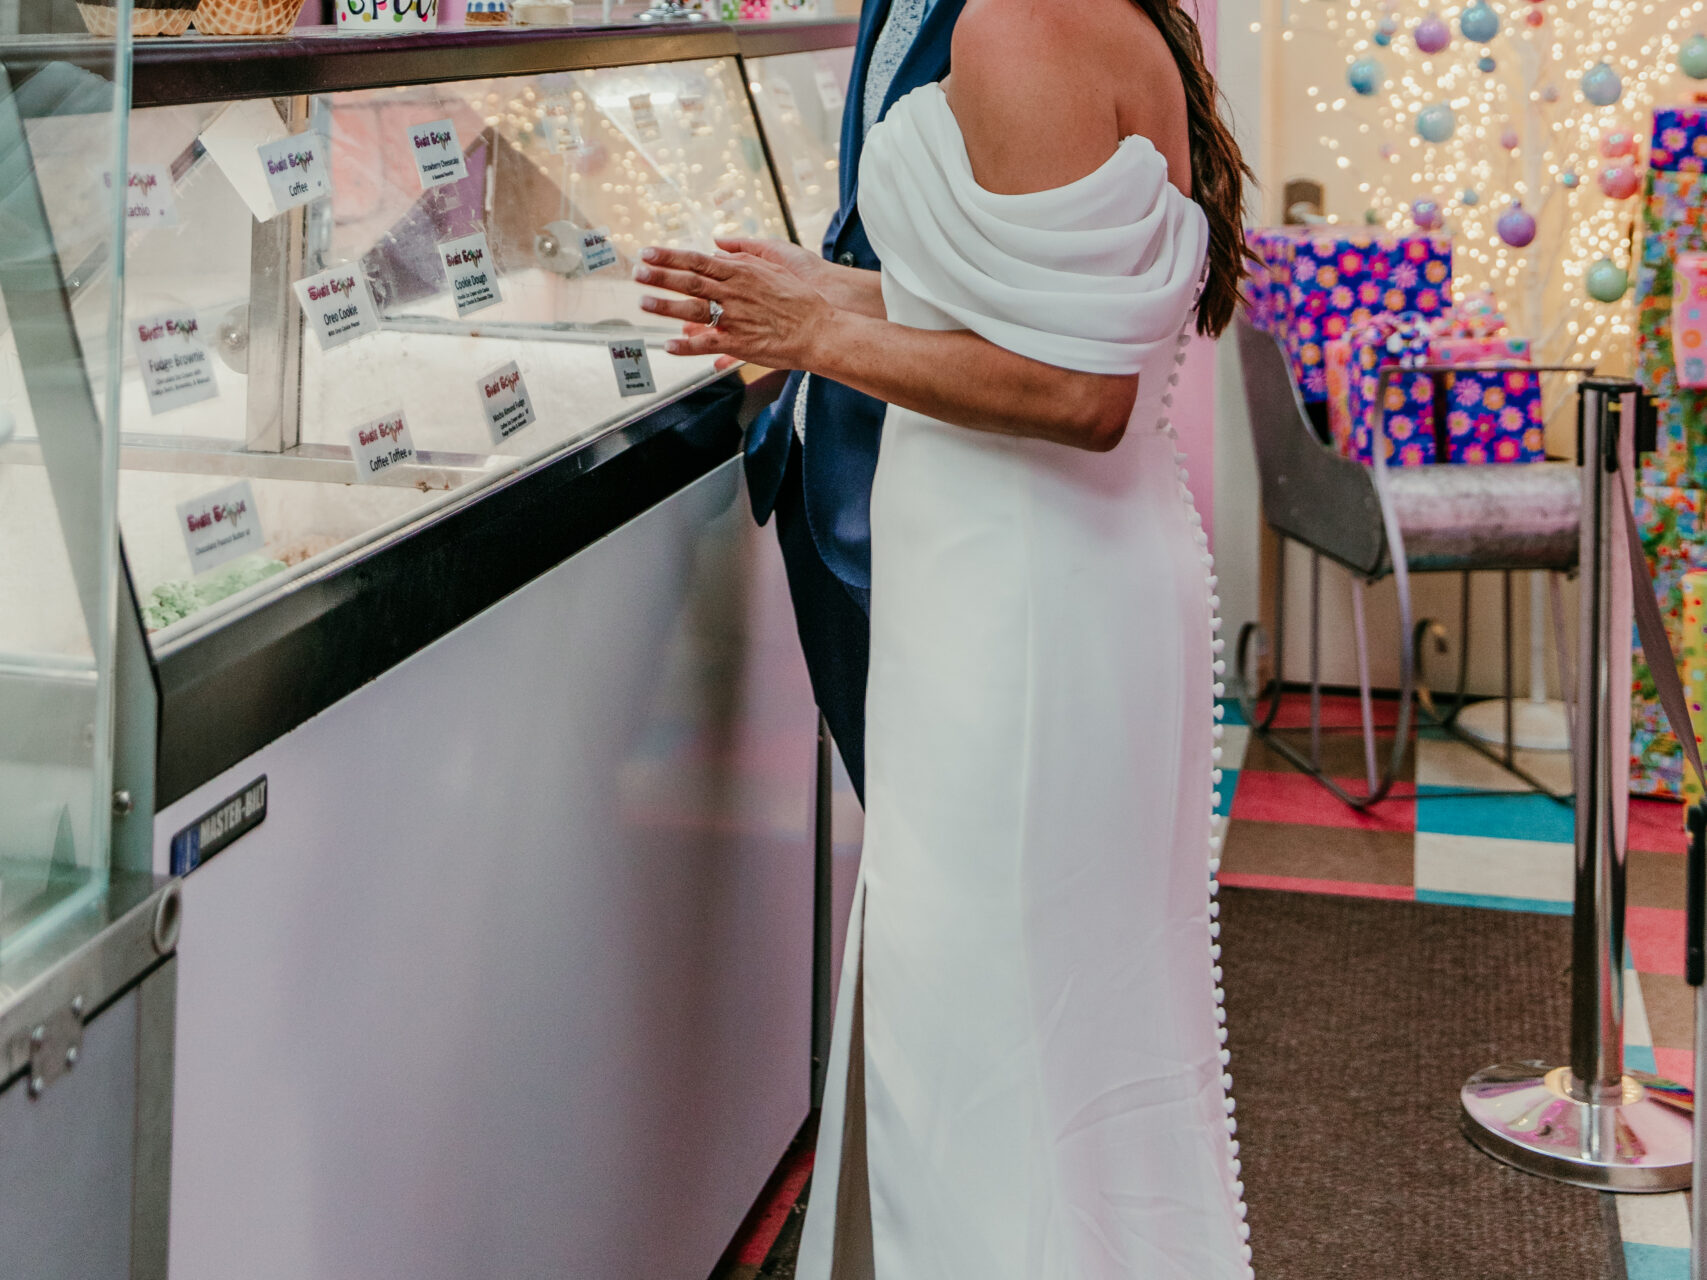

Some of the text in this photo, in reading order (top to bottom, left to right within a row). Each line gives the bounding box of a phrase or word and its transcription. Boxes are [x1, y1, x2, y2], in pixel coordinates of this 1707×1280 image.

[289, 182, 309, 197] Coffee
[455, 271, 488, 290] Cookie Dough
[324, 304, 359, 326] Oreo Cookie
[369, 447, 408, 472] Coffee Toffee
[200, 780, 265, 849] MASTER-BILT
